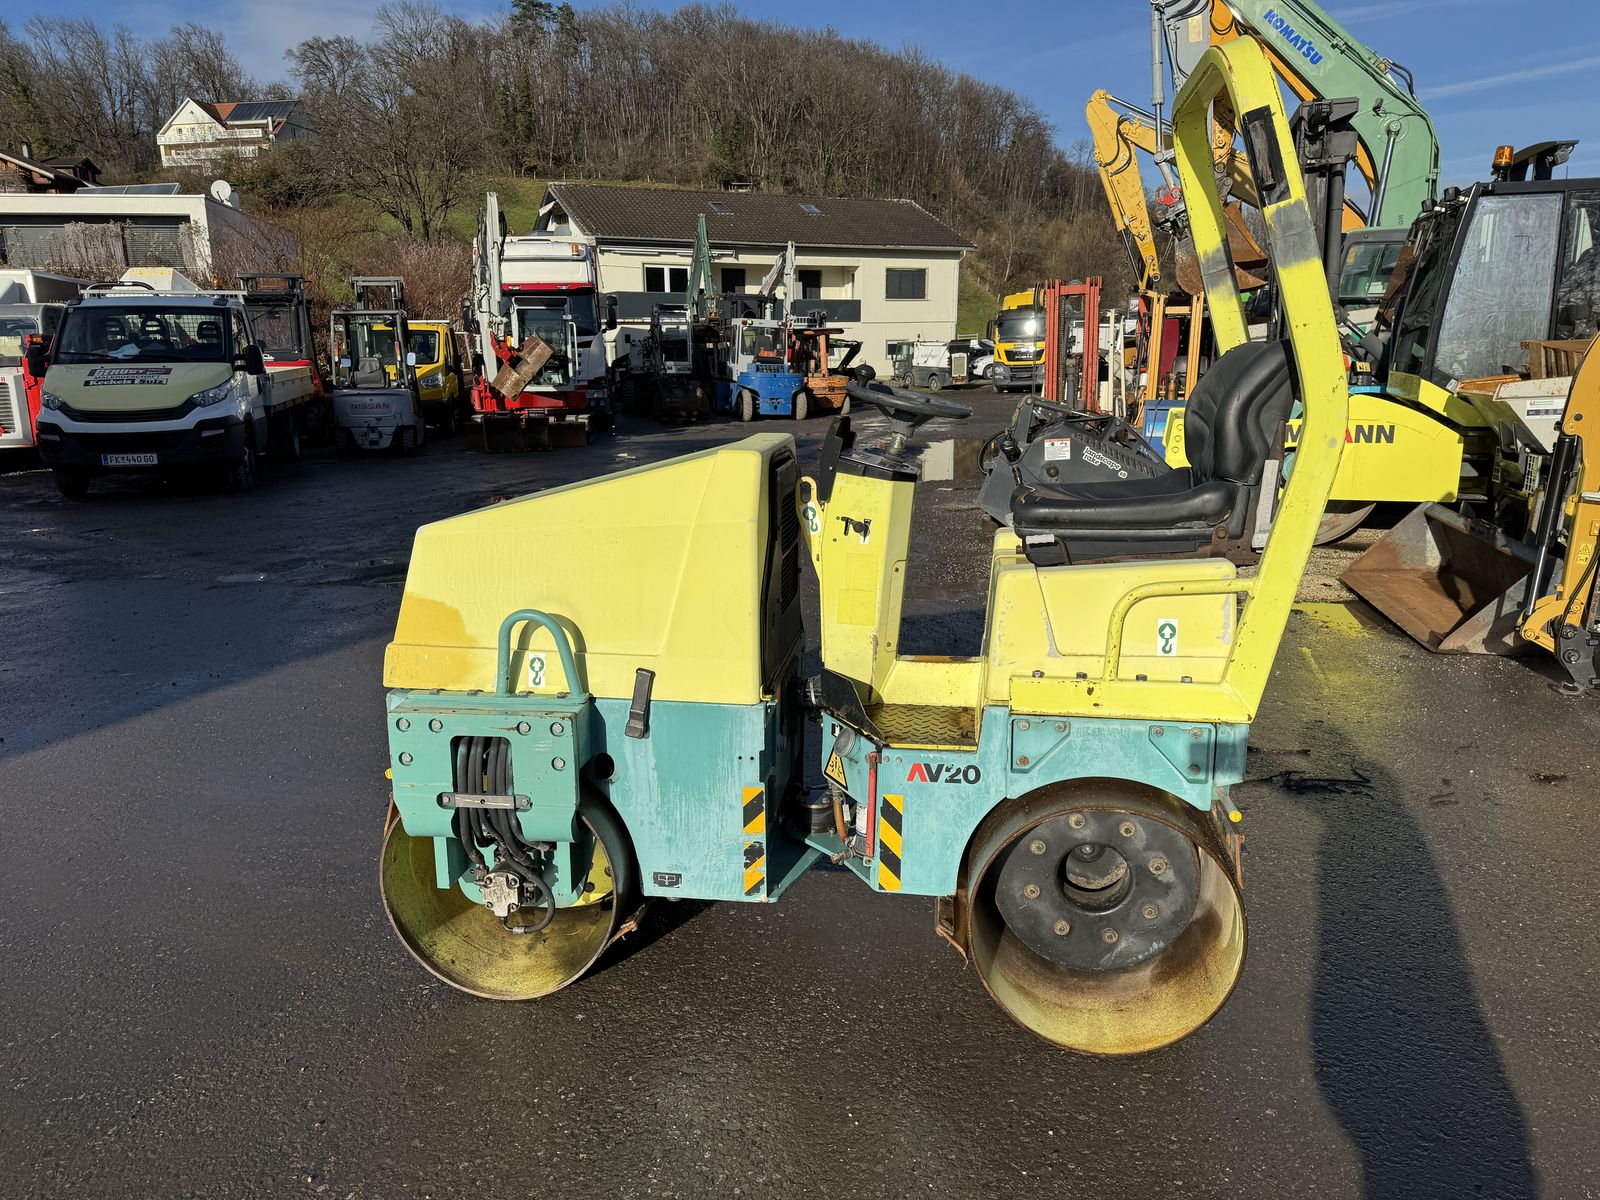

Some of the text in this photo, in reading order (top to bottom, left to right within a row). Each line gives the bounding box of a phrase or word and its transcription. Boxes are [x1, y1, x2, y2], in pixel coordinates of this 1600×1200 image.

[1263, 9, 1323, 64] KOMATSU
[109, 455, 121, 464] FK
[1083, 447, 1121, 470] landscape
[1083, 454, 1100, 466] rake
[906, 762, 981, 784] AV20
